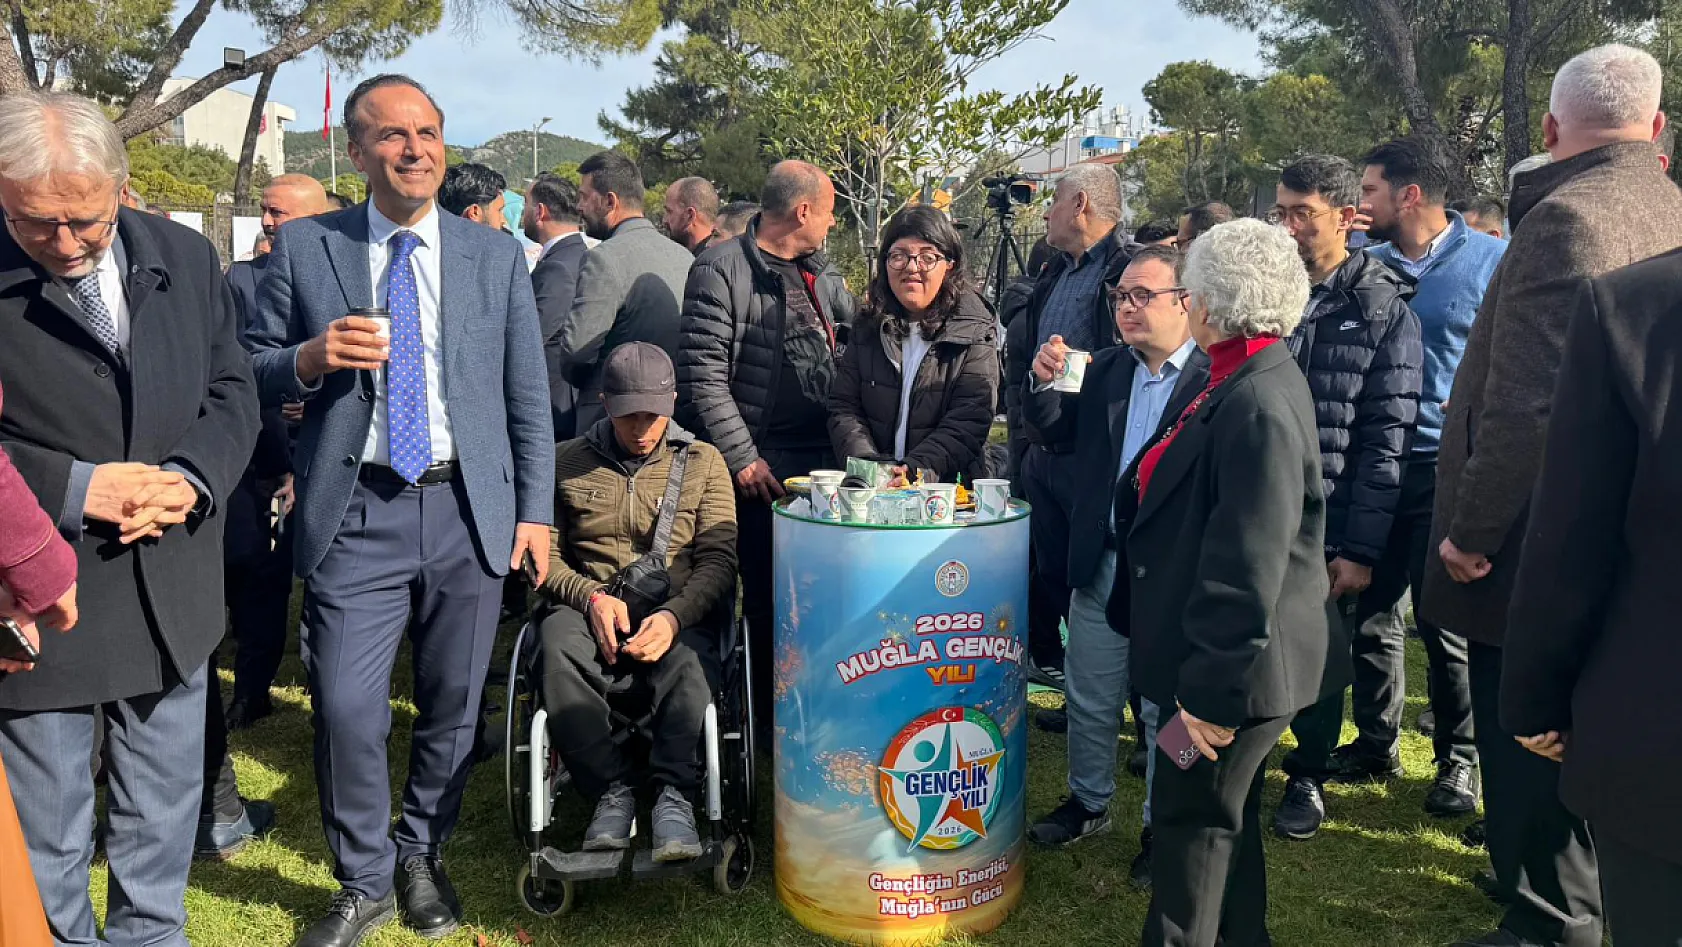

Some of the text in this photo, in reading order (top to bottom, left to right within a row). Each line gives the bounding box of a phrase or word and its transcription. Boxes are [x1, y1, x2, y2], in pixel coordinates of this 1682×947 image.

[917, 613, 983, 634] 2026
[837, 636, 1024, 684] MUĞLA GENÇLİK
[926, 665, 975, 684] YILI
[905, 762, 988, 798] GENÇLİK
[961, 788, 987, 810] YILI
[937, 826, 962, 836] 2026
[869, 874, 952, 895] Gençliğin
[880, 881, 1003, 918] Muğla'nın Gücü
